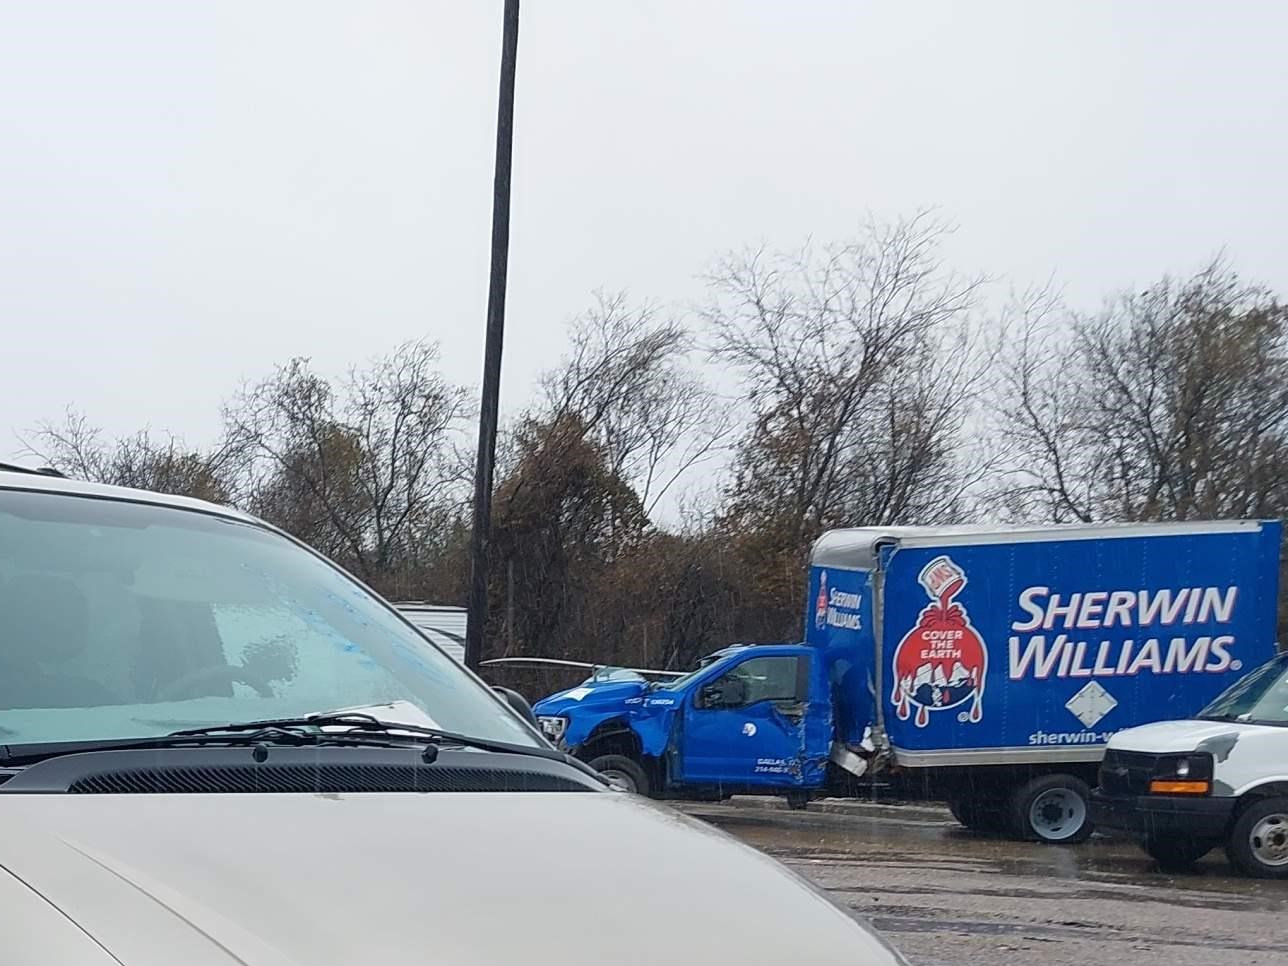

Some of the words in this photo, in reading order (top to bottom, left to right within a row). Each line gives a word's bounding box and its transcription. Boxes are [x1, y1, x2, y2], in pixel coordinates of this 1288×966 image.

[829, 587, 862, 609] SHERWIN
[1011, 585, 1239, 632] SHERWIN
[921, 630, 963, 640] COVER
[930, 640, 954, 649] THE
[920, 649, 962, 659] EARTH
